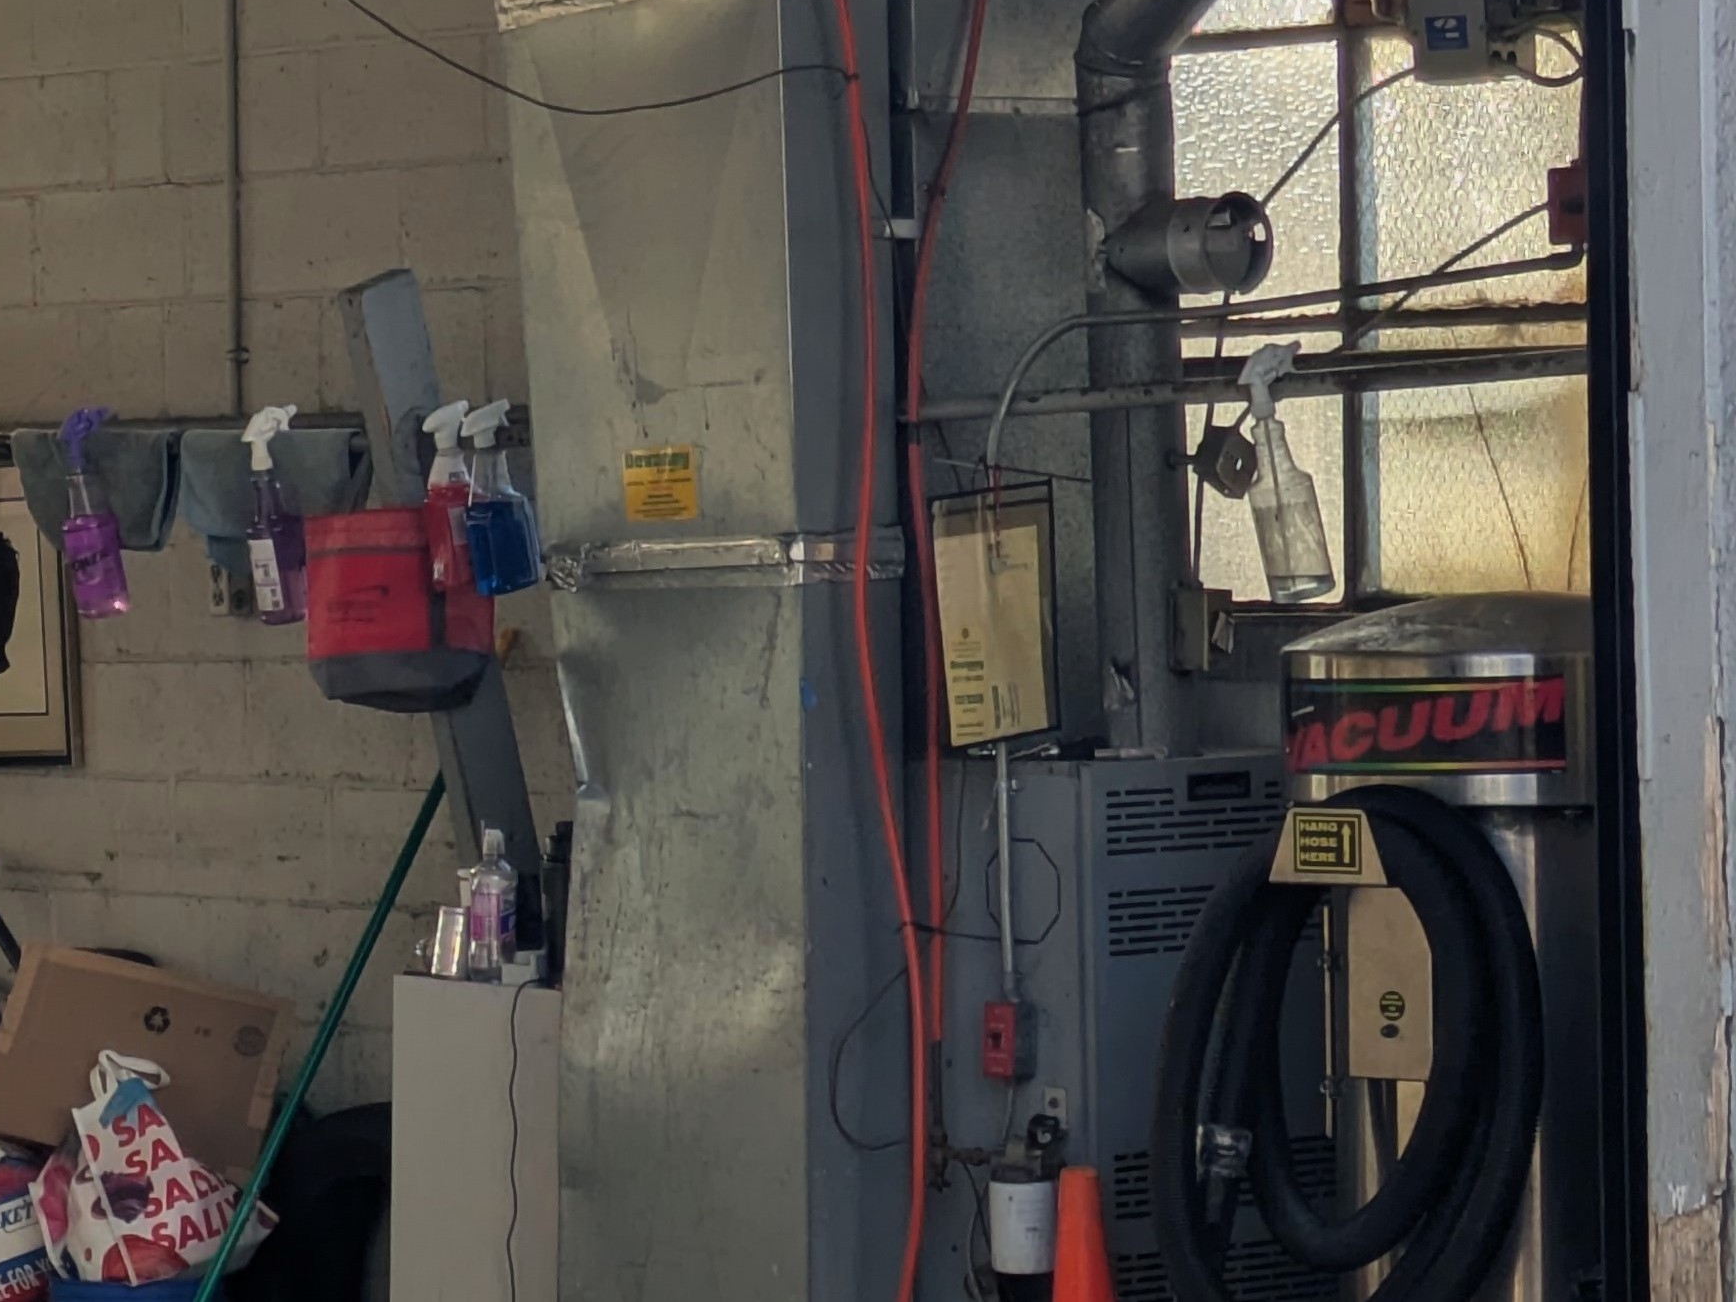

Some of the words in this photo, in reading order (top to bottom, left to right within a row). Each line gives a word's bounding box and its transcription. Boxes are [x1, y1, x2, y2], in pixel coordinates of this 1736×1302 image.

[1300, 821, 1338, 832] HANG
[1300, 836, 1338, 847] HOSE
[1300, 851, 1337, 862] HERE
